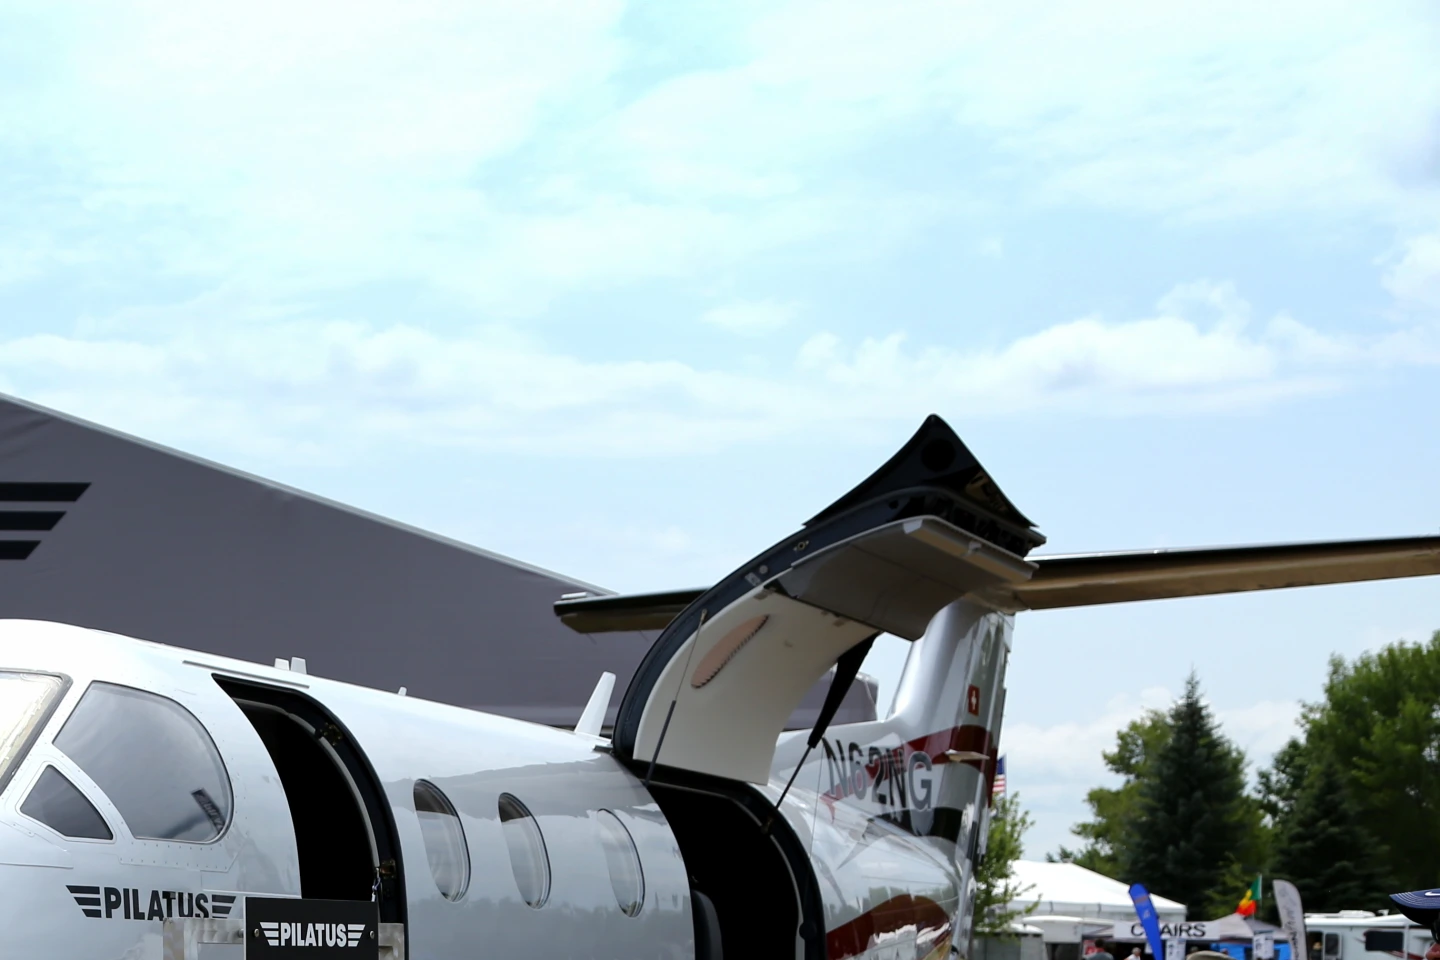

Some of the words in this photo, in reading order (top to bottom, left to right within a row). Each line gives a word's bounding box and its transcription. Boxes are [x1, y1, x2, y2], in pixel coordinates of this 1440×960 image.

[104, 887, 210, 921] PILATUS
[280, 922, 347, 948] PILATUS
[1130, 923, 1206, 938] CAIRS
